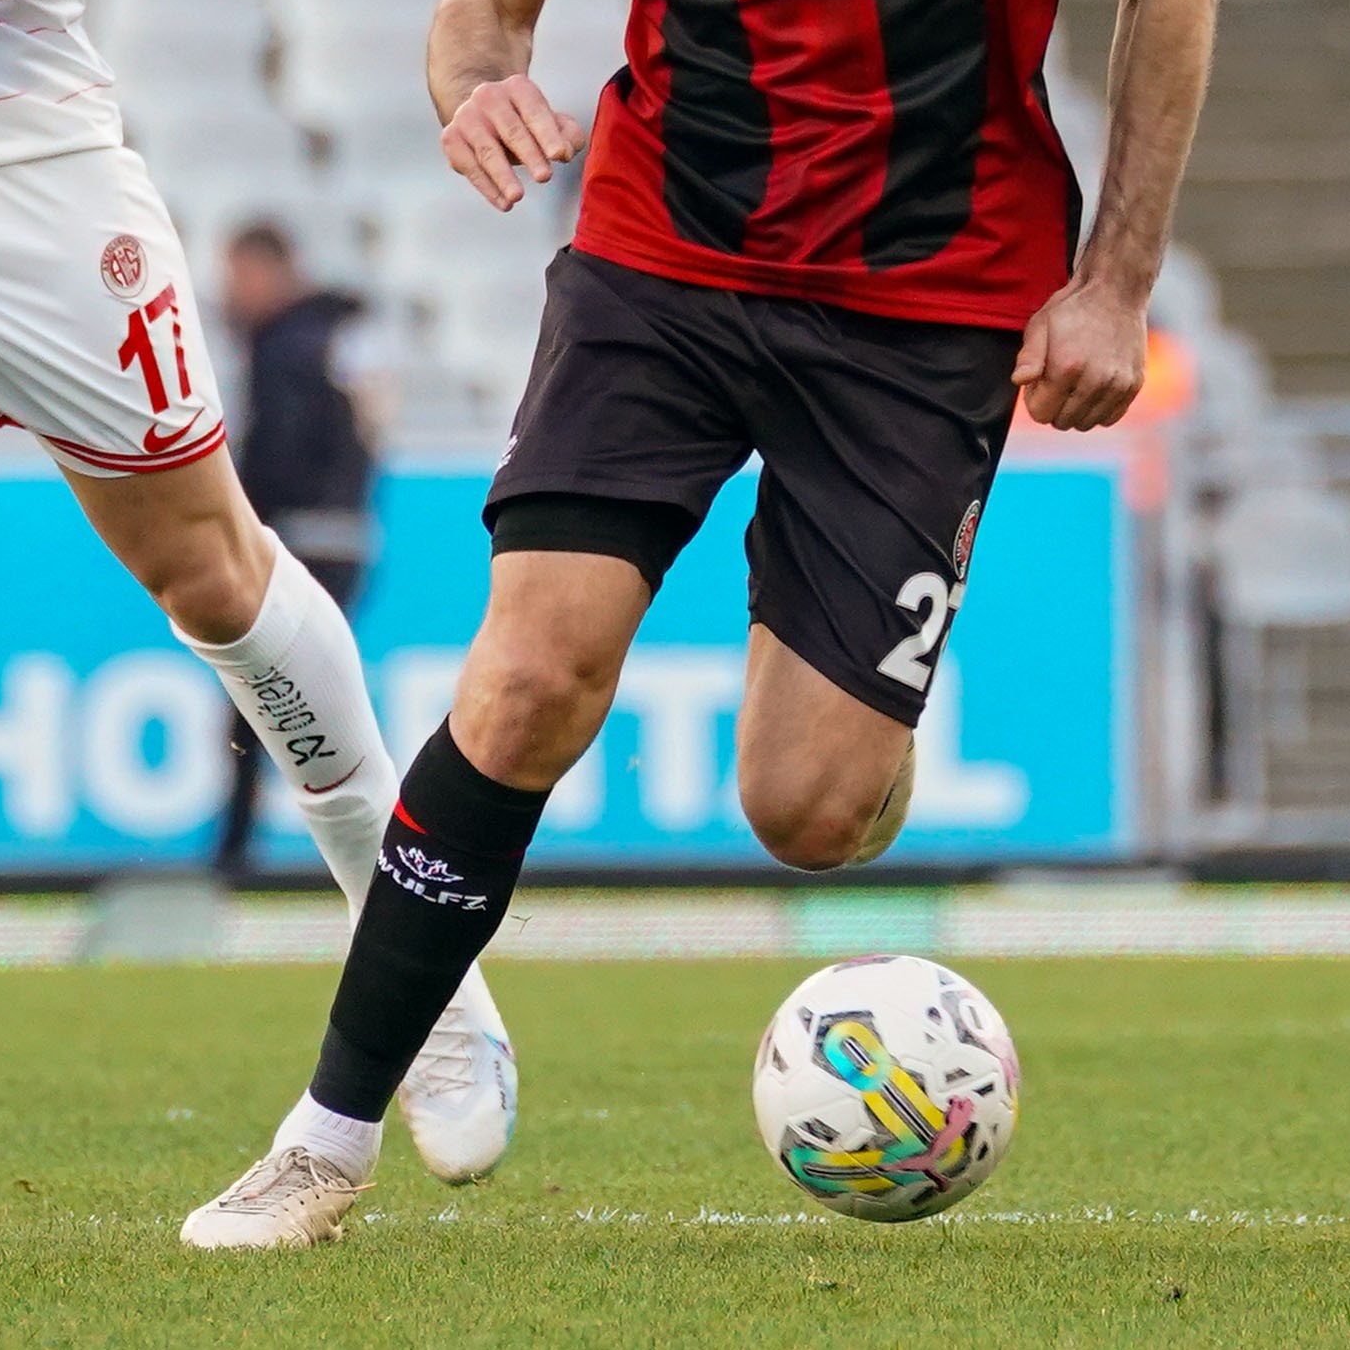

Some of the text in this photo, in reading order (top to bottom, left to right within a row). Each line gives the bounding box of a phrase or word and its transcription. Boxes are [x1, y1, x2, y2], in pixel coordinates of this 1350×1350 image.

[117, 281, 192, 415] 17
[876, 571, 966, 692] 2
[378, 848, 488, 912] WULFZ
